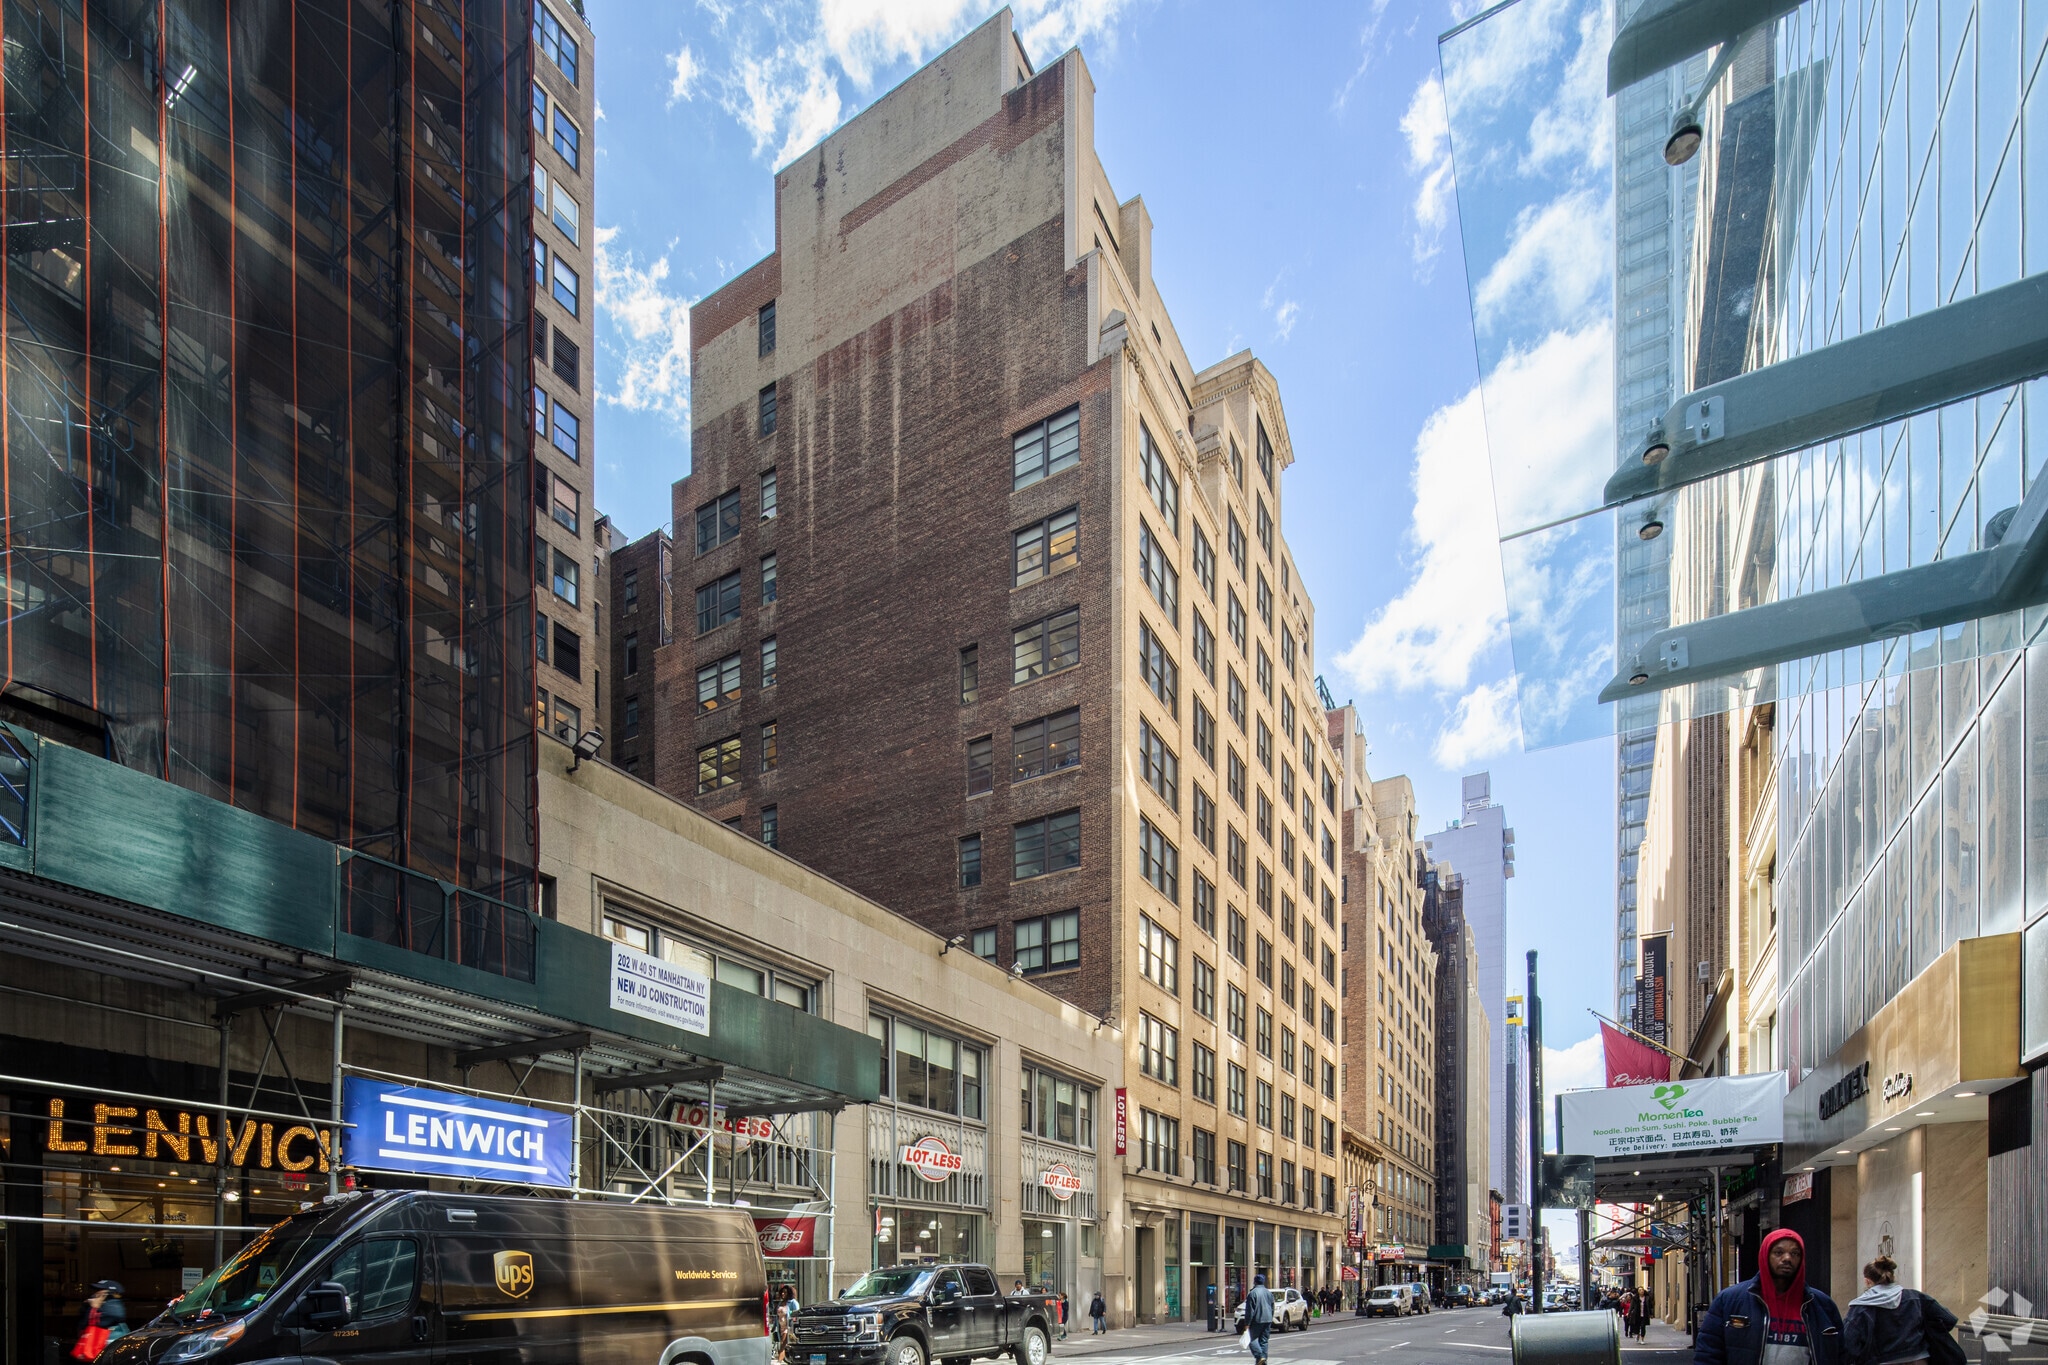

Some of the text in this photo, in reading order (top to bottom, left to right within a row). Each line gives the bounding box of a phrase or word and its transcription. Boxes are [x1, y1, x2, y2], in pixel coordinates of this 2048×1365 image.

[617, 953, 705, 995] 202 W 40 ST MANHATTAN NY
[617, 976, 705, 1017] NEW JD CONSTRUCTION
[1645, 951, 1654, 1047] CAIG NEWMARK GRADUATE
[1655, 976, 1664, 1020] JOURNALISM
[625, 1000, 635, 1008] more
[636, 1001, 657, 1015] information,
[1655, 1021, 1664, 1031] OF
[1117, 1095, 1125, 1149] LOT-LESS
[1638, 1108, 1704, 1122] MomenTea
[385, 1110, 544, 1161] LENWICH
[1593, 1127, 1623, 1136] Noodle.
[1624, 1125, 1640, 1133] Dim
[1642, 1123, 1661, 1132] Sum.
[1663, 1121, 1687, 1130] Sushi.
[1688, 1119, 1710, 1128] Poke.
[1712, 1116, 1741, 1125] Bubble
[1633, 1142, 1668, 1151] Delivery:
[1672, 1137, 1733, 1148] momenteausa.com
[905, 1147, 961, 1169] LOT-LESS
[1044, 1173, 1080, 1190] LOT-LESS
[759, 1232, 801, 1242] OT-LESS
[262, 1269, 274, 1281] A
[498, 1264, 532, 1291] ups
[675, 1270, 738, 1279] Worldwide Services
